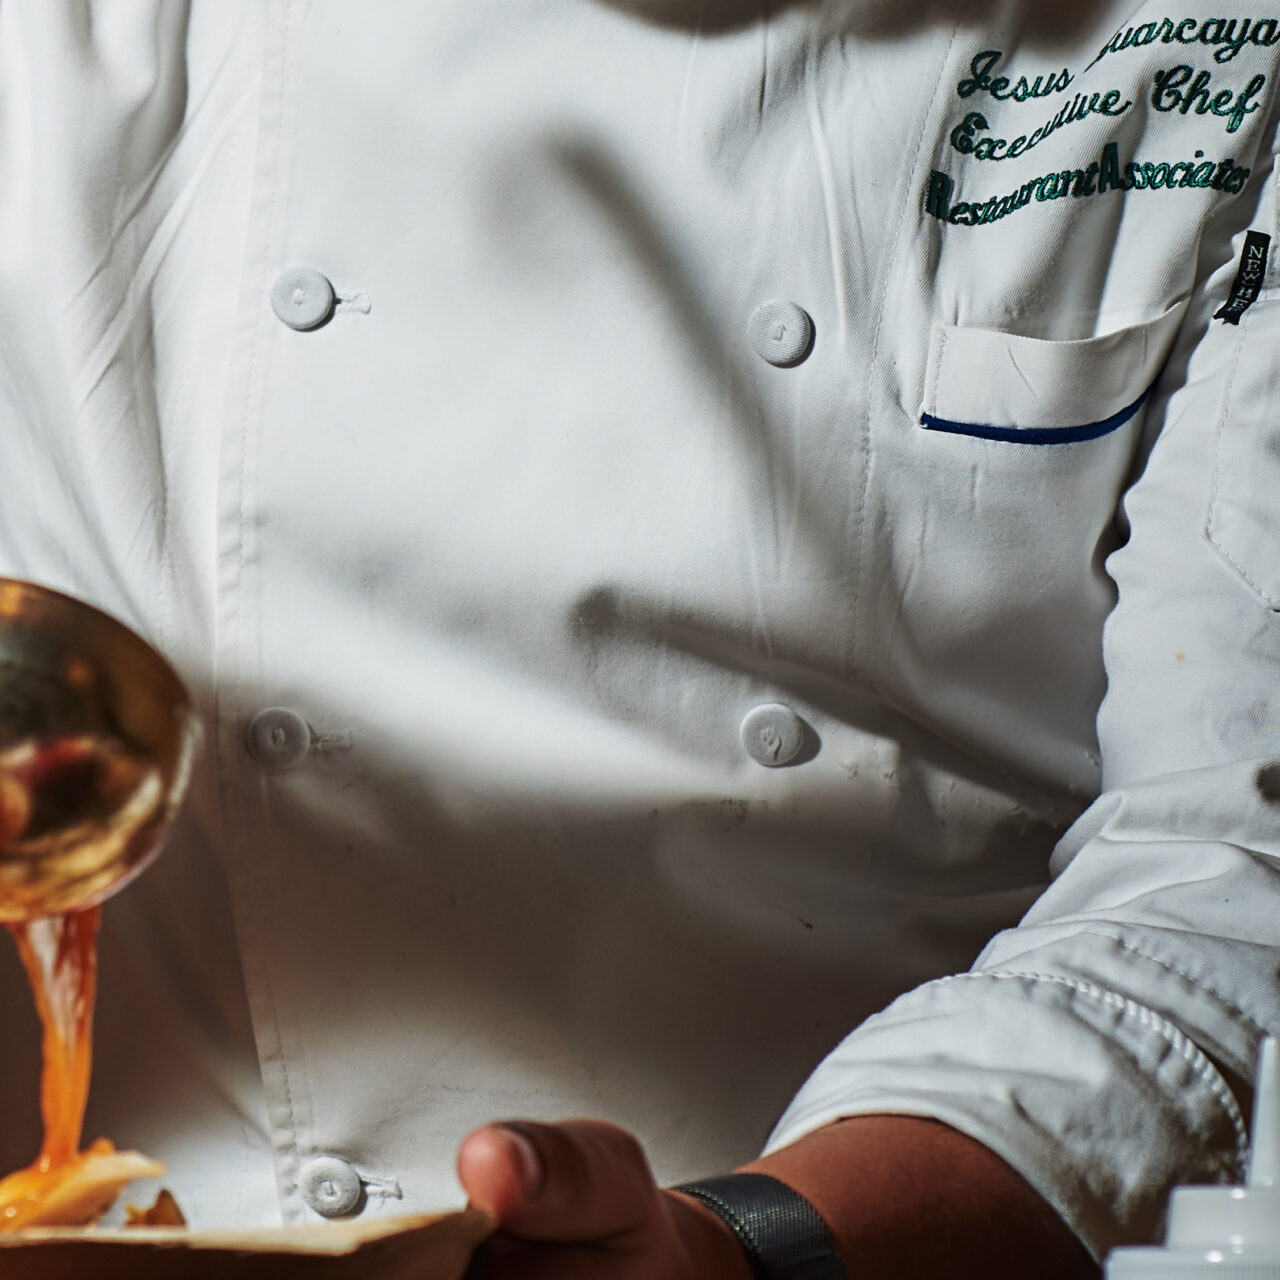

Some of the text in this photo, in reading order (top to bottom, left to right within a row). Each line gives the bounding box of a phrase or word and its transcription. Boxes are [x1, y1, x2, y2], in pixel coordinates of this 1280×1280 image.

[956, 17, 1280, 102] Jesus uarcaya
[1151, 63, 1266, 133] Chef
